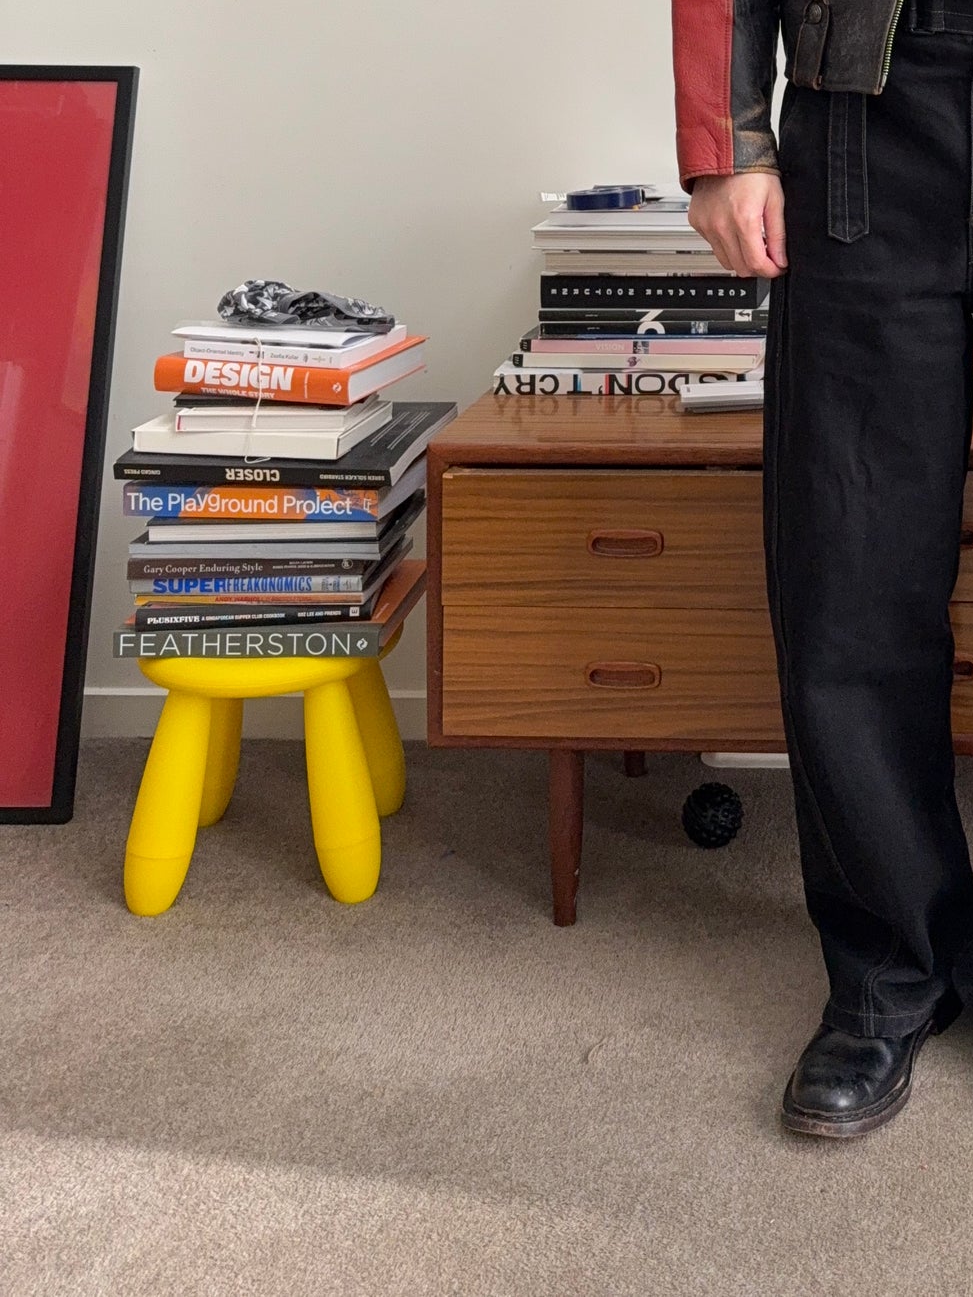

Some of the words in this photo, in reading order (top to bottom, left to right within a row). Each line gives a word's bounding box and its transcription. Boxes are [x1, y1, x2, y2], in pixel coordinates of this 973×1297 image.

[645, 289, 696, 297] PAPER
[707, 289, 747, 297] ACNE
[595, 343, 625, 351] VISION
[184, 360, 294, 391] DESIGN
[494, 373, 559, 395] CRY
[201, 387, 217, 395] THE
[218, 388, 247, 397] WHOLE
[248, 390, 275, 399] STORY
[225, 468, 280, 482] CLOSER
[127, 492, 163, 511] The
[168, 493, 278, 514] Playground
[283, 492, 352, 515] Project
[143, 564, 164, 575] Gary
[165, 564, 197, 575] Cooper
[199, 563, 240, 575] Enduring
[241, 563, 264, 574] Style
[118, 633, 350, 656] FEATHERSTON
